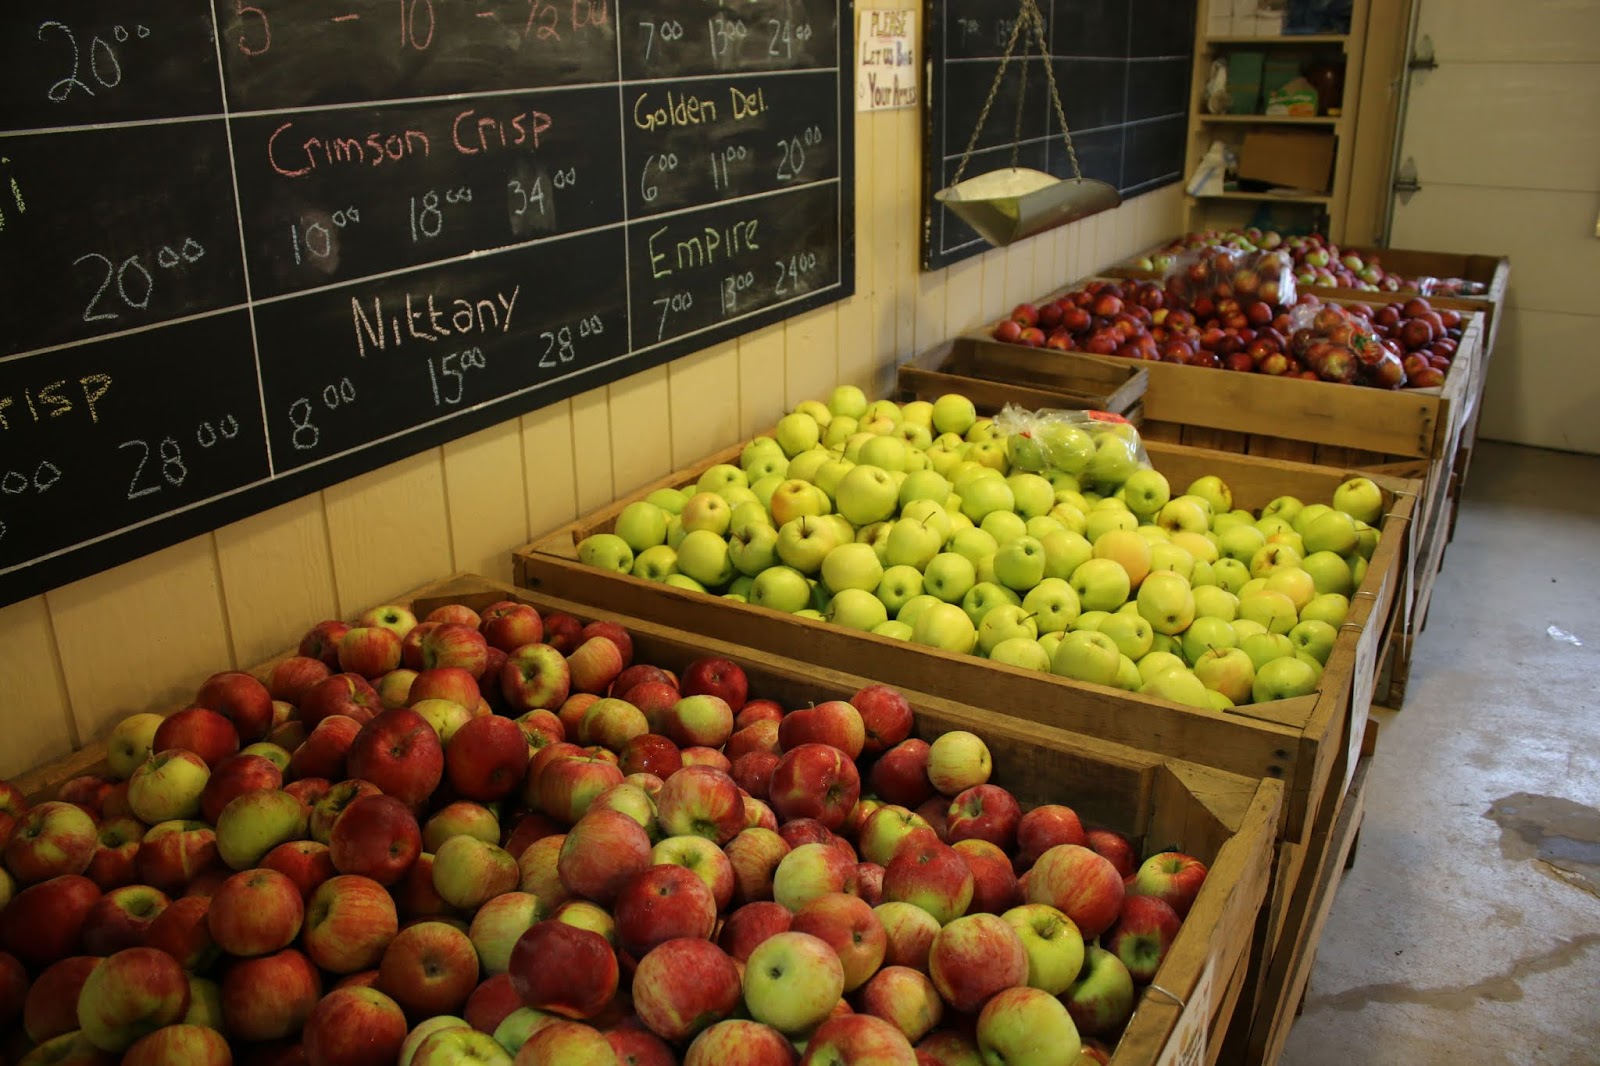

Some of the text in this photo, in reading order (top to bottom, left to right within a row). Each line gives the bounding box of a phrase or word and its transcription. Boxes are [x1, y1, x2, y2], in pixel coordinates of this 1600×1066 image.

[400, 0, 434, 50] 10
[634, 91, 716, 132] Golden
[268, 109, 552, 177] Crimson Crisp
[649, 219, 759, 278] Empire
[352, 285, 520, 357] Nittany
